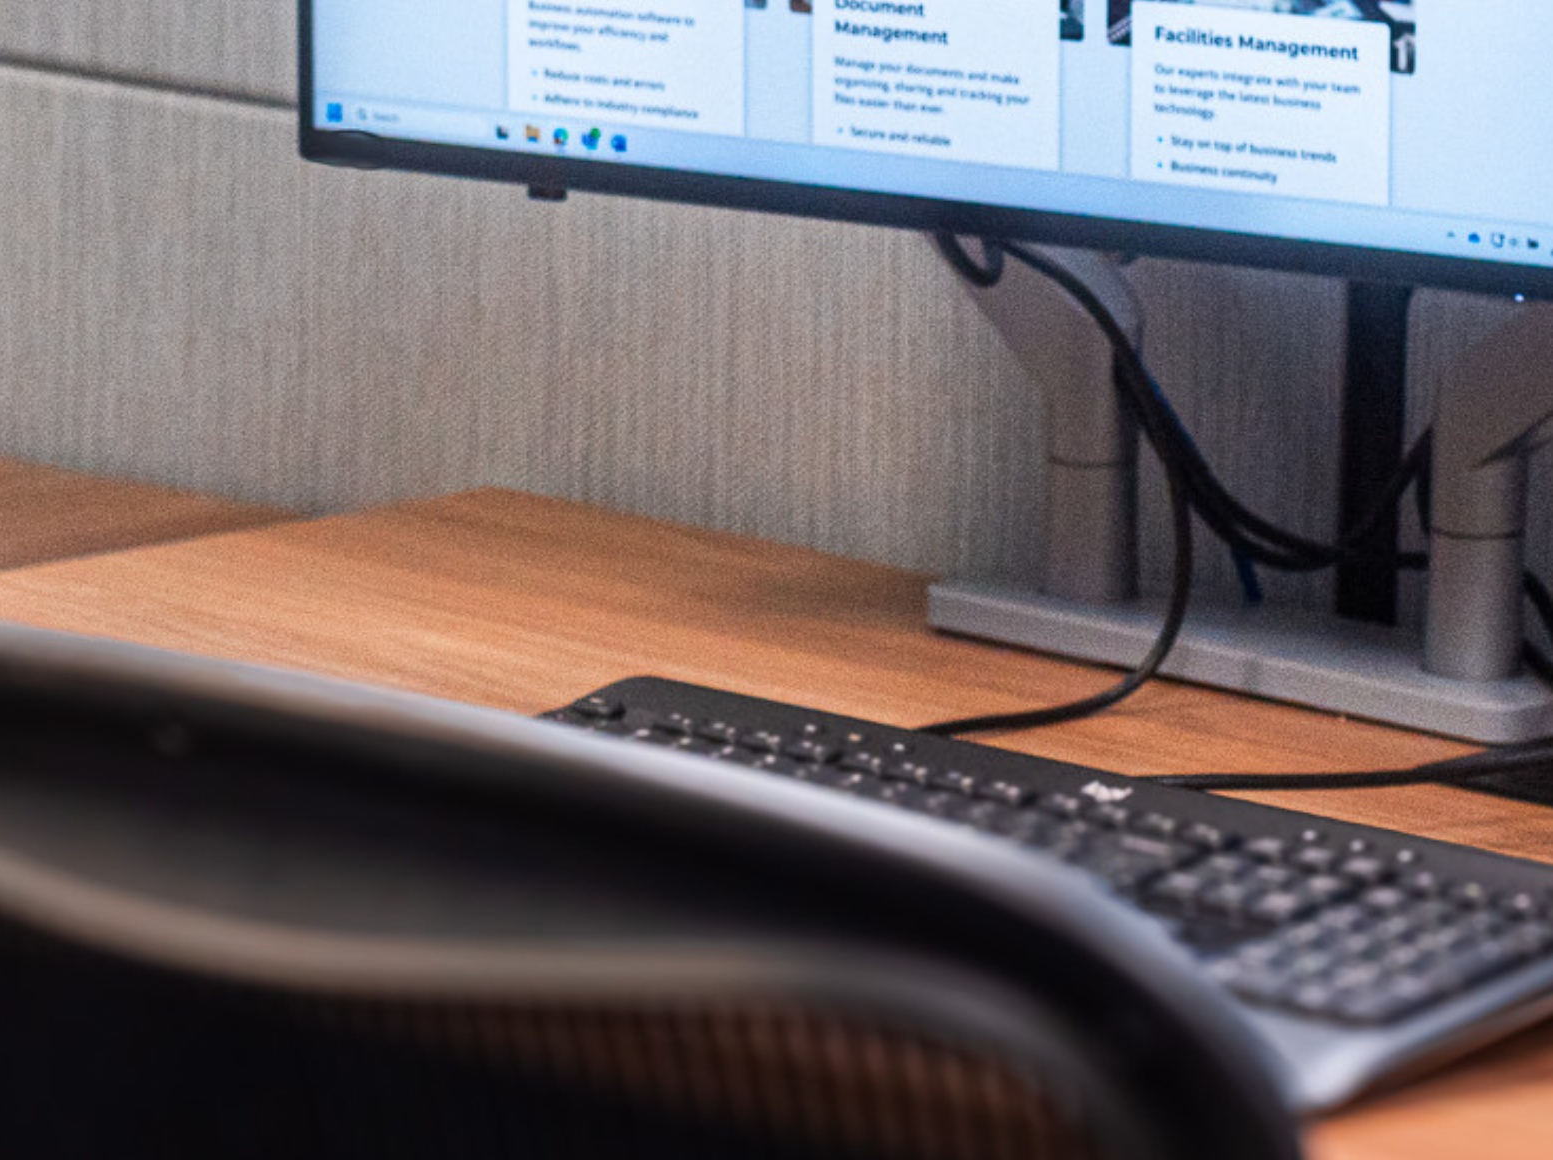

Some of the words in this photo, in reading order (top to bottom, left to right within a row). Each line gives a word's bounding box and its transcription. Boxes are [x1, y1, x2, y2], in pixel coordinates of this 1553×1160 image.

[528, 0, 571, 13] Business
[576, 4, 635, 19] automation
[638, 10, 680, 25] software
[685, 16, 695, 27] to
[528, 20, 569, 33] improve
[573, 23, 594, 35] your
[649, 32, 669, 42] and
[834, 20, 948, 45] Management
[1155, 26, 1233, 48] Facilities
[1239, 34, 1359, 61] Management
[544, 68, 580, 82] Reduce
[613, 76, 631, 87] and
[834, 56, 874, 72] Manage
[879, 61, 902, 73] your
[907, 64, 963, 79] documents
[969, 71, 987, 81] and
[991, 73, 1020, 84] make
[1155, 63, 1174, 75] Our
[1178, 67, 1219, 80] experts
[1223, 69, 1272, 85] integrate
[1276, 76, 1299, 87] with
[1303, 80, 1328, 93] your
[1331, 83, 1361, 94] team
[834, 93, 855, 104] files
[859, 97, 889, 108] easier
[894, 100, 916, 111] than
[895, 81, 933, 97] sharing
[937, 86, 956, 96] and
[960, 88, 1002, 105] tracking
[1006, 93, 1029, 105] your
[1155, 84, 1166, 93] to
[1169, 84, 1214, 101] leverage
[1218, 89, 1235, 100] the
[1240, 91, 1269, 105] latest
[1274, 95, 1322, 110] business
[544, 93, 579, 106] Adhere
[584, 97, 594, 106] to
[598, 97, 638, 114] industry
[642, 103, 698, 119] compliance
[851, 127, 885, 139] Secure
[889, 131, 908, 141] and
[912, 132, 951, 147] reliable
[1171, 135, 1194, 150] Stay
[1197, 140, 1210, 149] on
[1214, 140, 1232, 154] top
[1236, 142, 1247, 153] of
[1250, 144, 1297, 159] business
[1301, 149, 1337, 163] trends
[1171, 160, 1218, 176] Business
[1222, 166, 1278, 185] continuity
